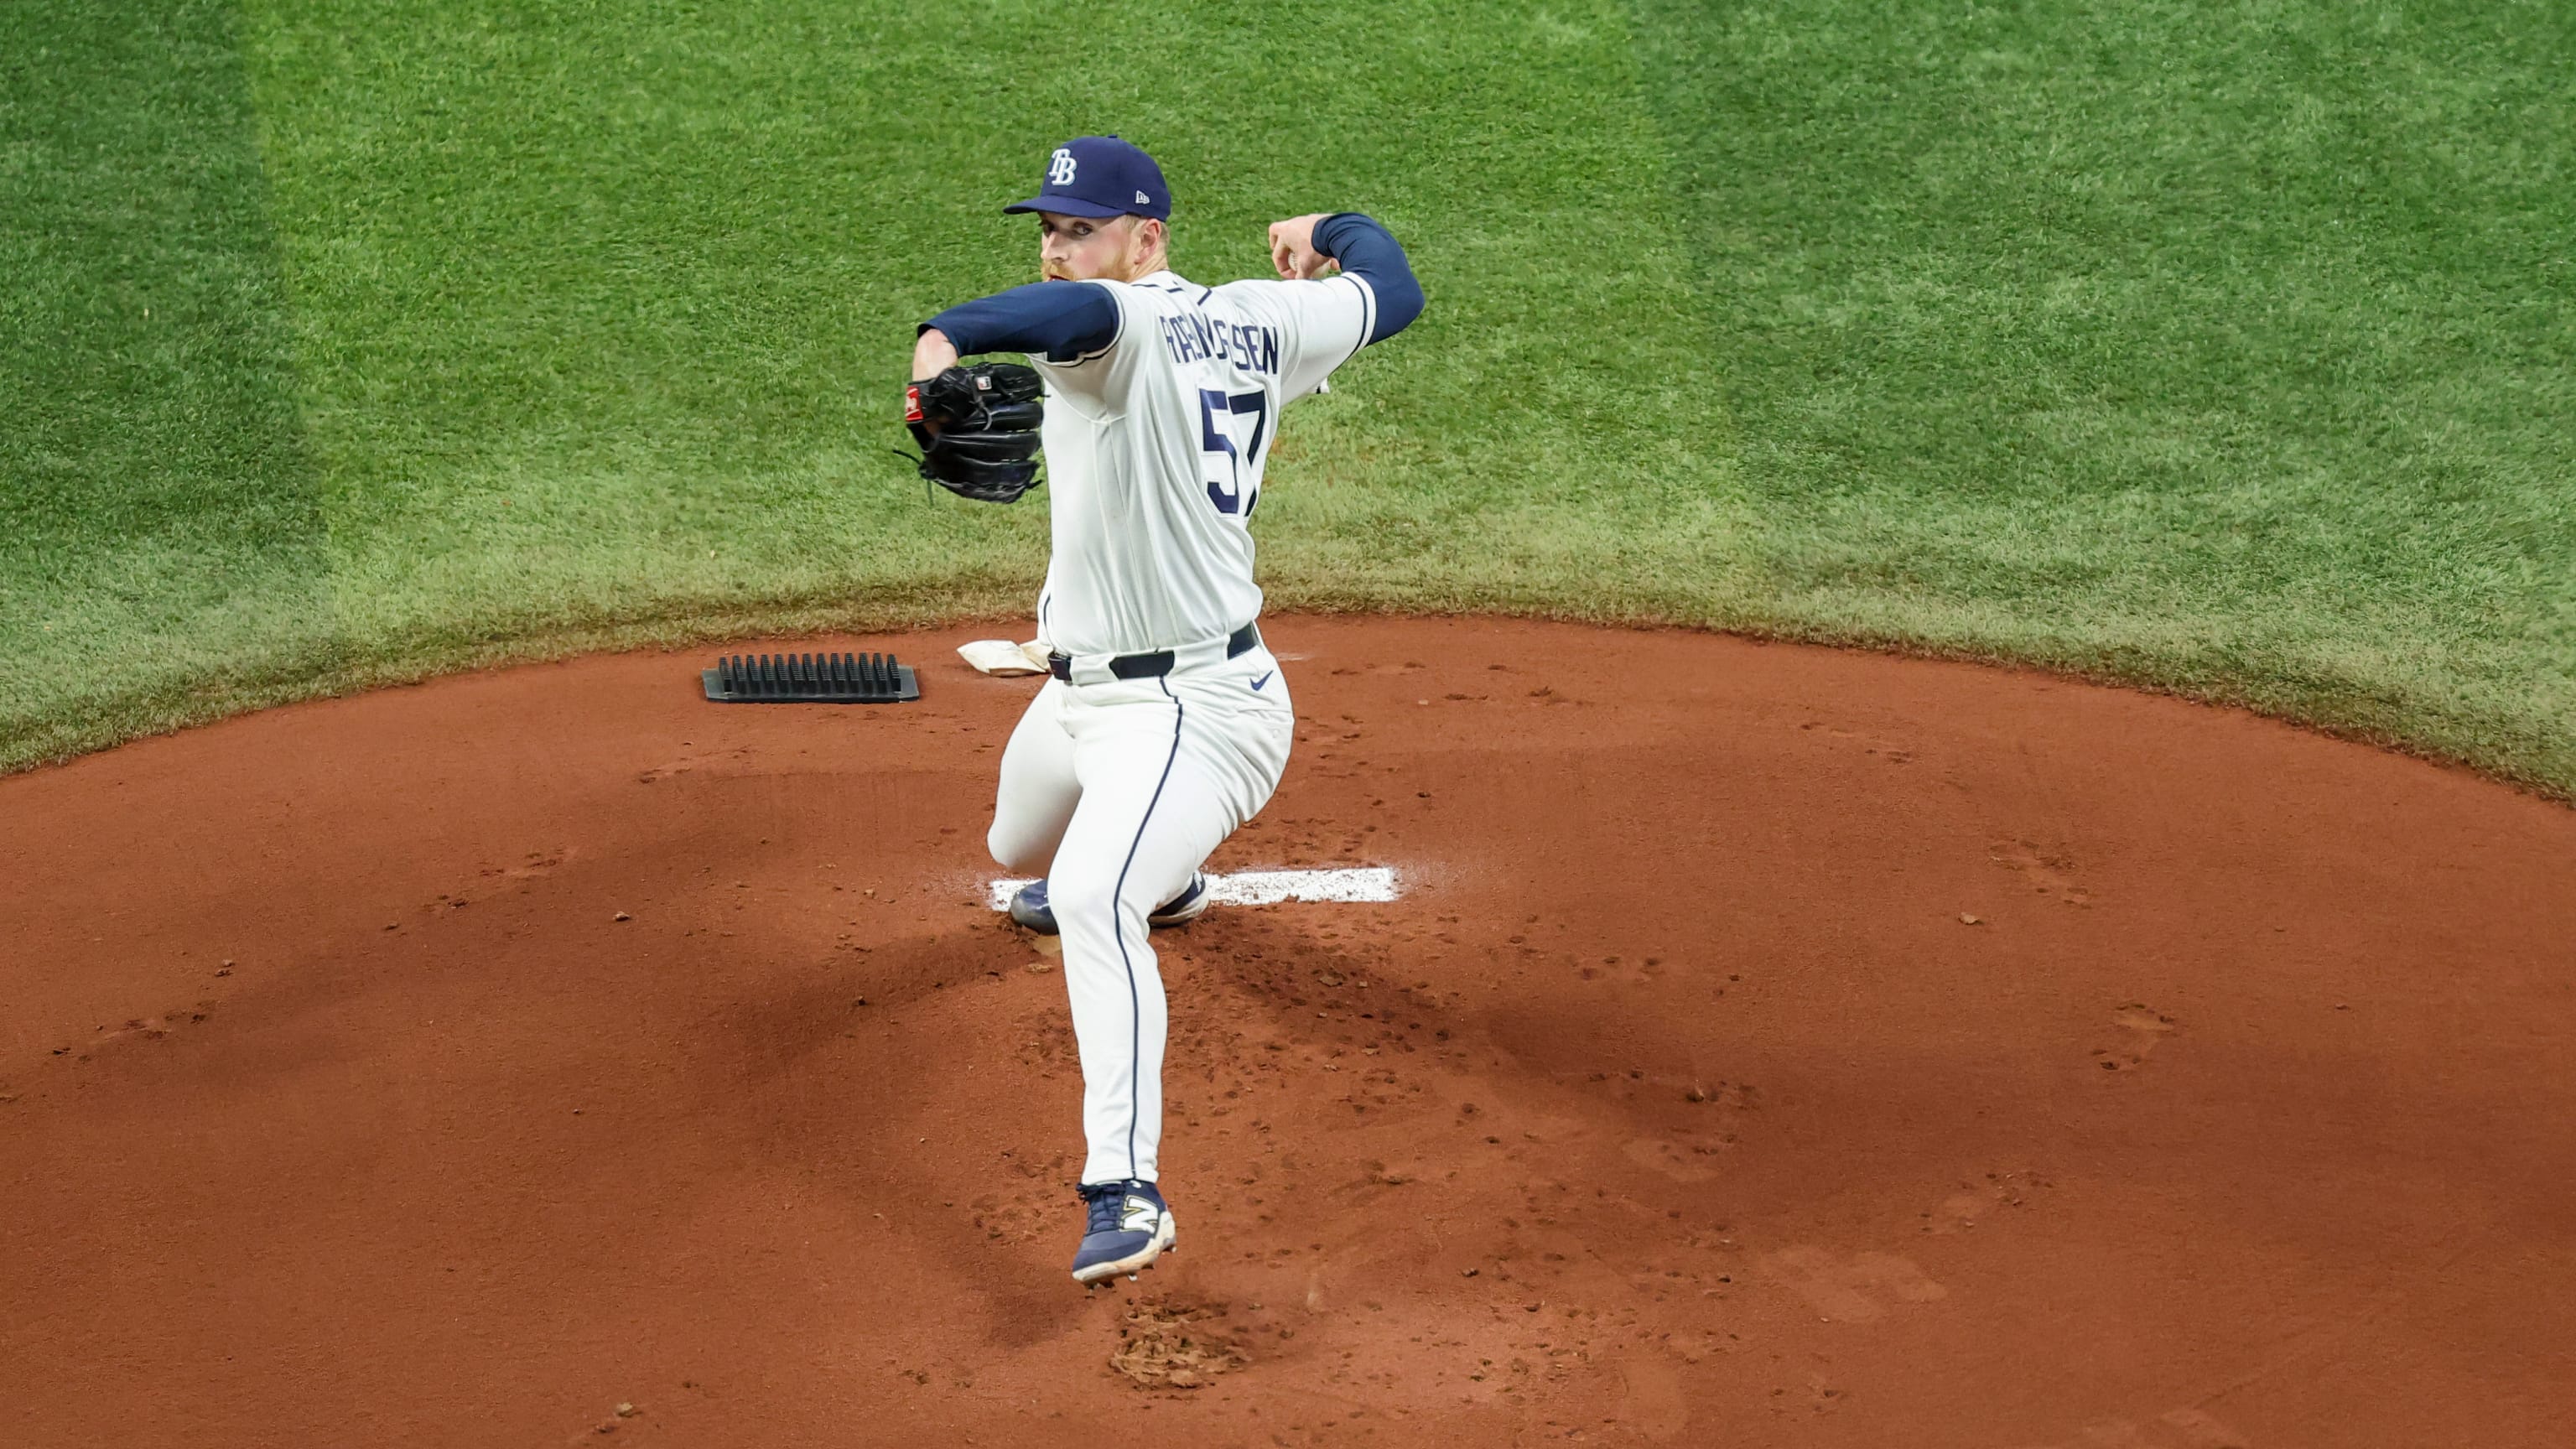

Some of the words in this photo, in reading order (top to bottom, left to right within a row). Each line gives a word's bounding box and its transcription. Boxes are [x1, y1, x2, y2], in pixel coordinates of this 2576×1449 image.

[1049, 148, 1077, 185] TB
[1160, 314, 1278, 375] RASSEN
[1198, 389, 1265, 517] 57
